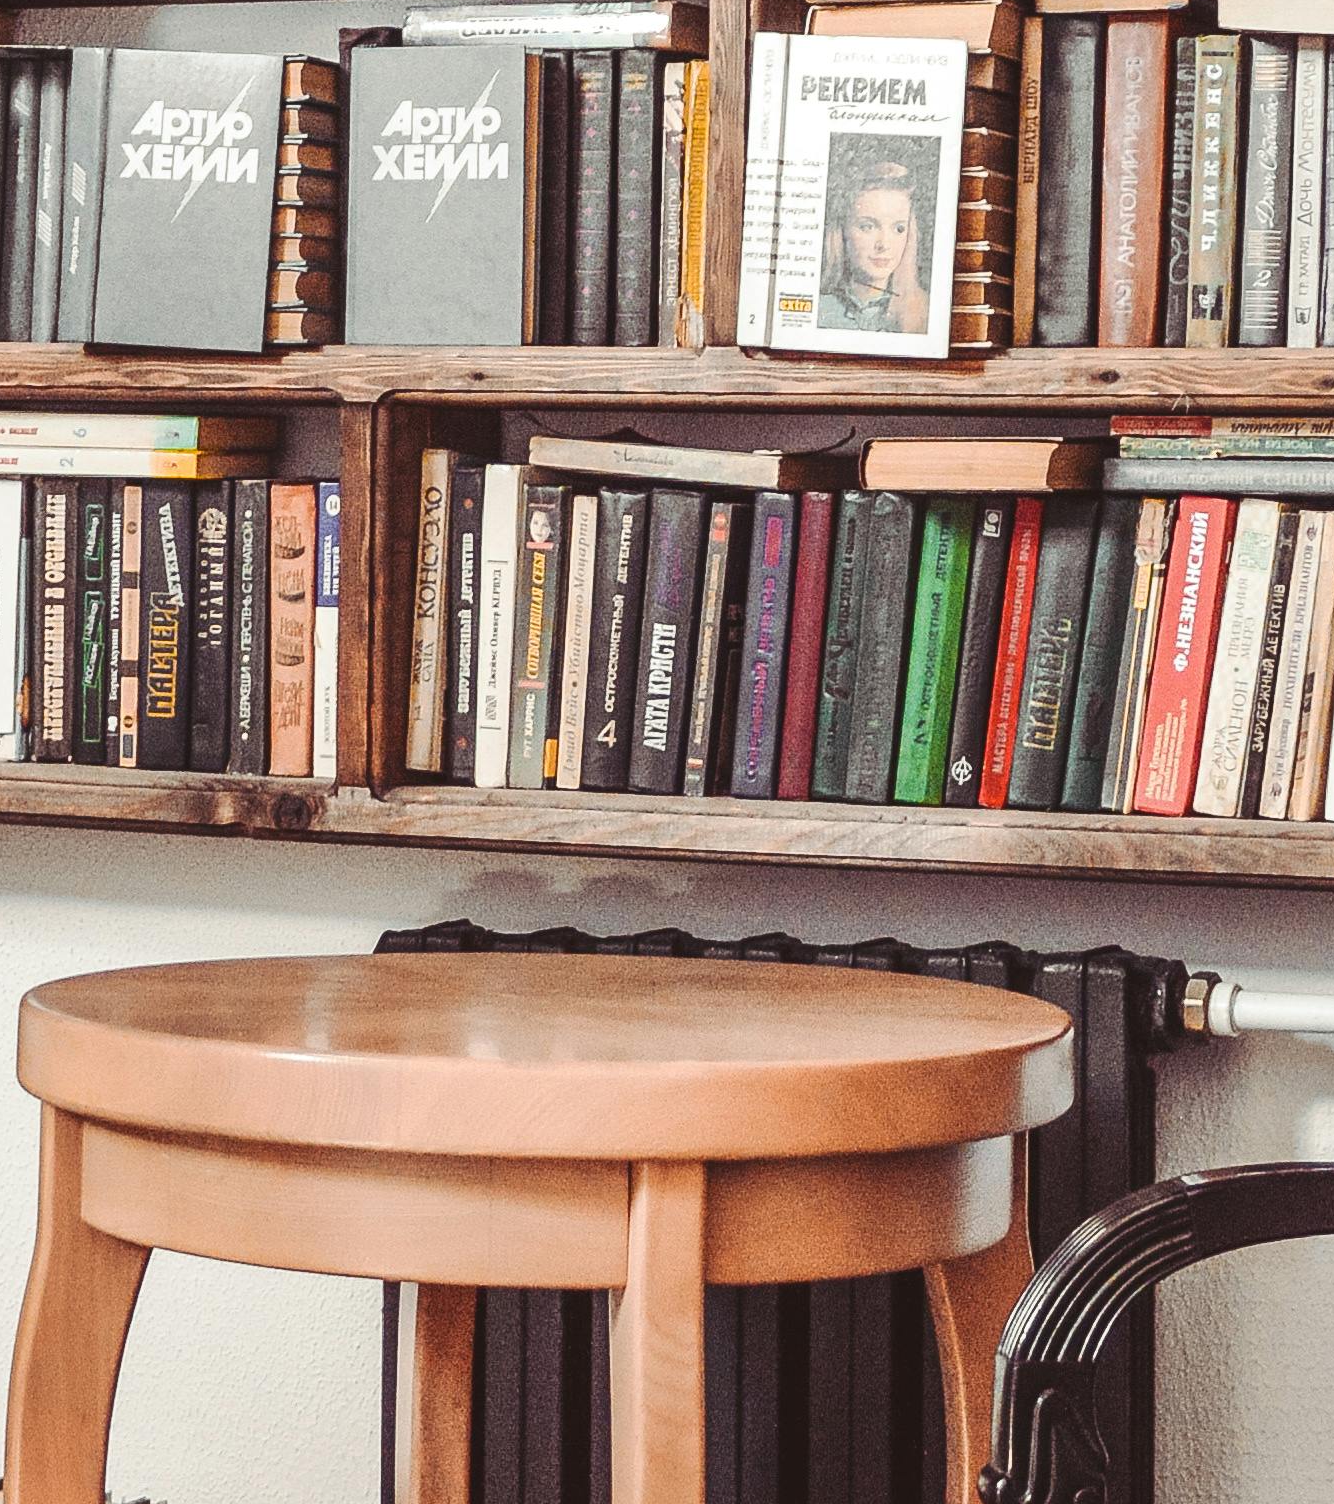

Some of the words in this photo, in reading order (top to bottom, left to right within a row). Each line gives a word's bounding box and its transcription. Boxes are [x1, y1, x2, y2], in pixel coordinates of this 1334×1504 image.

[800, 75, 928, 106] РЕКВИЕМ
[828, 103, 949, 127] блондинкам
[1025, 76, 1039, 111] ШОУ
[1121, 55, 1144, 141] ИВАНОВ
[1297, 58, 1317, 173] Монтесумы
[1023, 115, 1039, 185] БЕРНАРД
[666, 177, 679, 251] ХЕМИНГУЭЙ
[1116, 149, 1141, 267] АНАТОЛИЙ
[1296, 178, 1314, 228] Дочь
[666, 257, 678, 307] ЭРНЕСТ
[779, 298, 813, 312] extra
[1252, 269, 1272, 287] 2
[749, 314, 756, 325] 2
[111, 511, 122, 557] ГАМБИТ
[158, 503, 185, 607] ДЕТЕКТИВА
[243, 521, 254, 580] ПЕЧАТКОЙ
[417, 486, 442, 620] КОНСУЭЛО
[571, 512, 590, 591] Моцарта
[616, 514, 634, 585] ДЕТЕКТИВ
[110, 559, 121, 620] ТУРЕЦКИЙ
[242, 583, 253, 593] С
[491, 569, 502, 609] КЕРВУД
[531, 550, 547, 585] СЕБЯ
[1173, 512, 1209, 673] Ф.НЕЗНАНСКИЙ
[1293, 544, 1314, 634] БРИЛЛИАНТОВ
[109, 628, 119, 667] Акунин
[241, 595, 253, 652] ПЕРСТЕНЬ
[489, 610, 502, 647] Оливер
[526, 588, 545, 680] СОТВОРИВШАЯ
[569, 594, 585, 676] Убийство
[42, 604, 65, 741] ПРЕСТУПЛЕНИЕ
[146, 592, 179, 718] МАСТЕРА
[488, 649, 499, 689] Джеймс
[604, 594, 625, 713] ОСТРОСЮЖЕТНЫЙ
[646, 622, 677, 695] КРИСТИ
[1251, 658, 1276, 753] ЗАРУБЕЖНЫЙ
[1265, 584, 1286, 655] ДЕТЕКТИВ
[1282, 629, 1302, 710] ПОХИТИТЕЛИ
[108, 668, 119, 701] Борис
[522, 693, 537, 737] ХАРРИС
[595, 719, 617, 749] 4
[643, 698, 669, 751] АГАТА
[1225, 680, 1248, 772] СИМЕНОН
[991, 721, 1008, 774] МАСТЕРА
